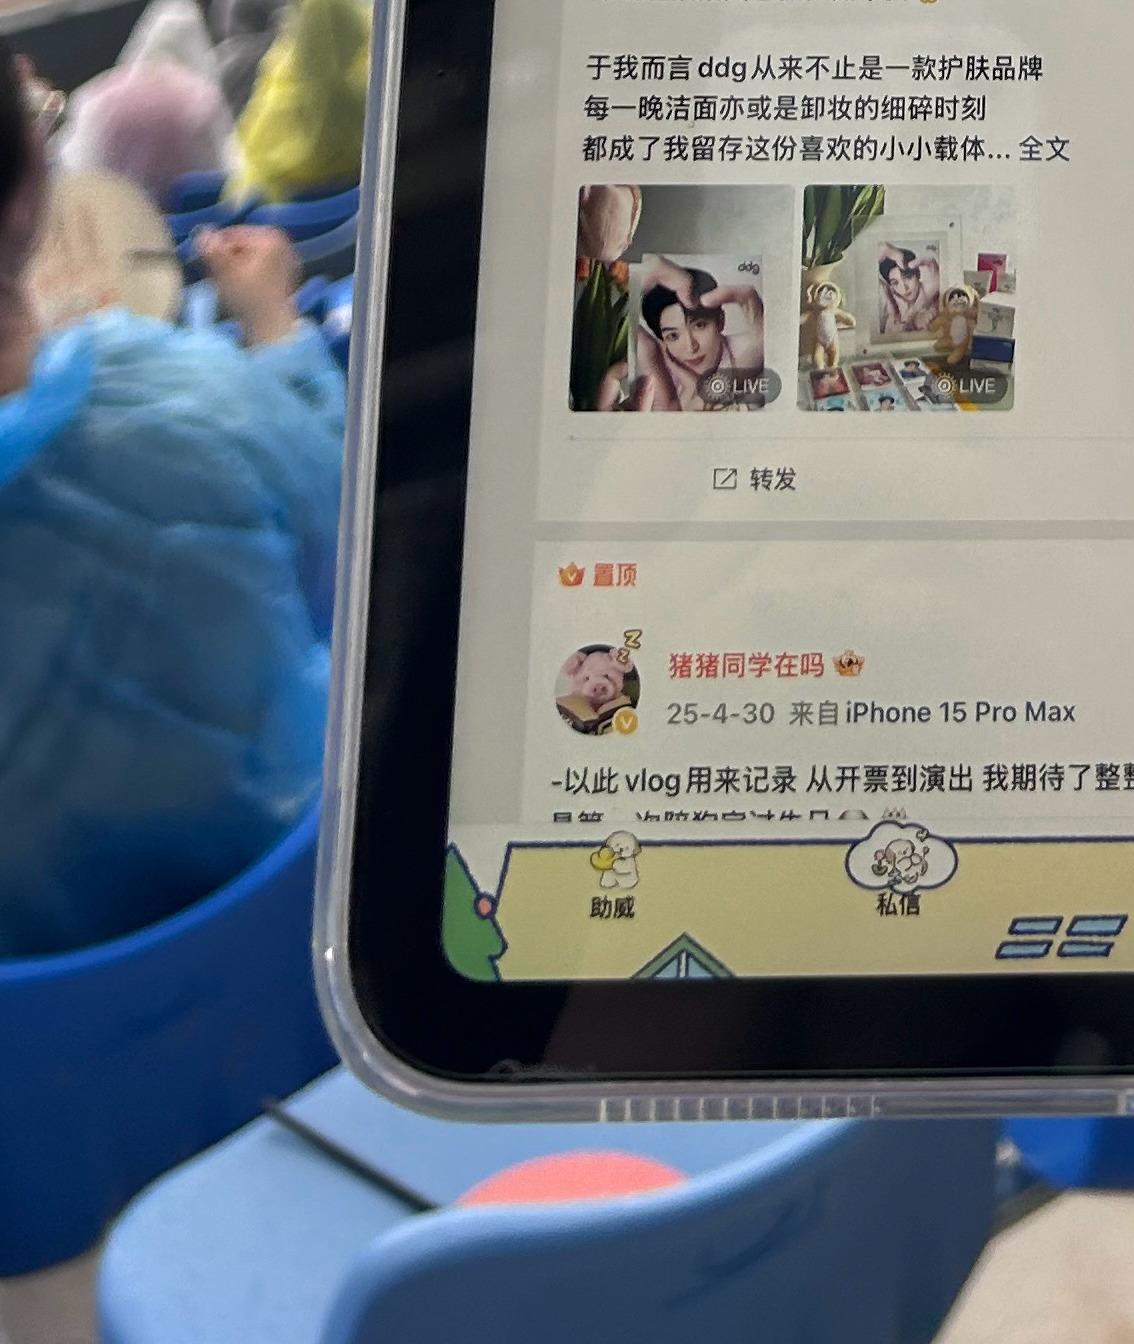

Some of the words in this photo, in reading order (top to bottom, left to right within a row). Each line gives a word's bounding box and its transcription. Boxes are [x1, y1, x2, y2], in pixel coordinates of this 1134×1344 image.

[583, 94, 986, 122] 每一晚洁面亦或是卸妆的细碎时刻
[1018, 135, 1070, 162] 全文
[733, 377, 769, 393] LIVE
[959, 378, 996, 393] LIVE
[750, 467, 796, 492] 转发
[593, 563, 637, 587] 置顶
[669, 651, 825, 679] 猪猪同学在吗
[667, 702, 776, 726] 25-4-30
[789, 699, 839, 727] 来自
[846, 700, 932, 724] iPhone
[939, 701, 967, 724] 15
[975, 701, 1017, 723] Pro
[1025, 700, 1076, 723] Max
[805, 763, 973, 793] 从开票到演出
[589, 895, 635, 920] 助威
[875, 892, 922, 917] 私信
